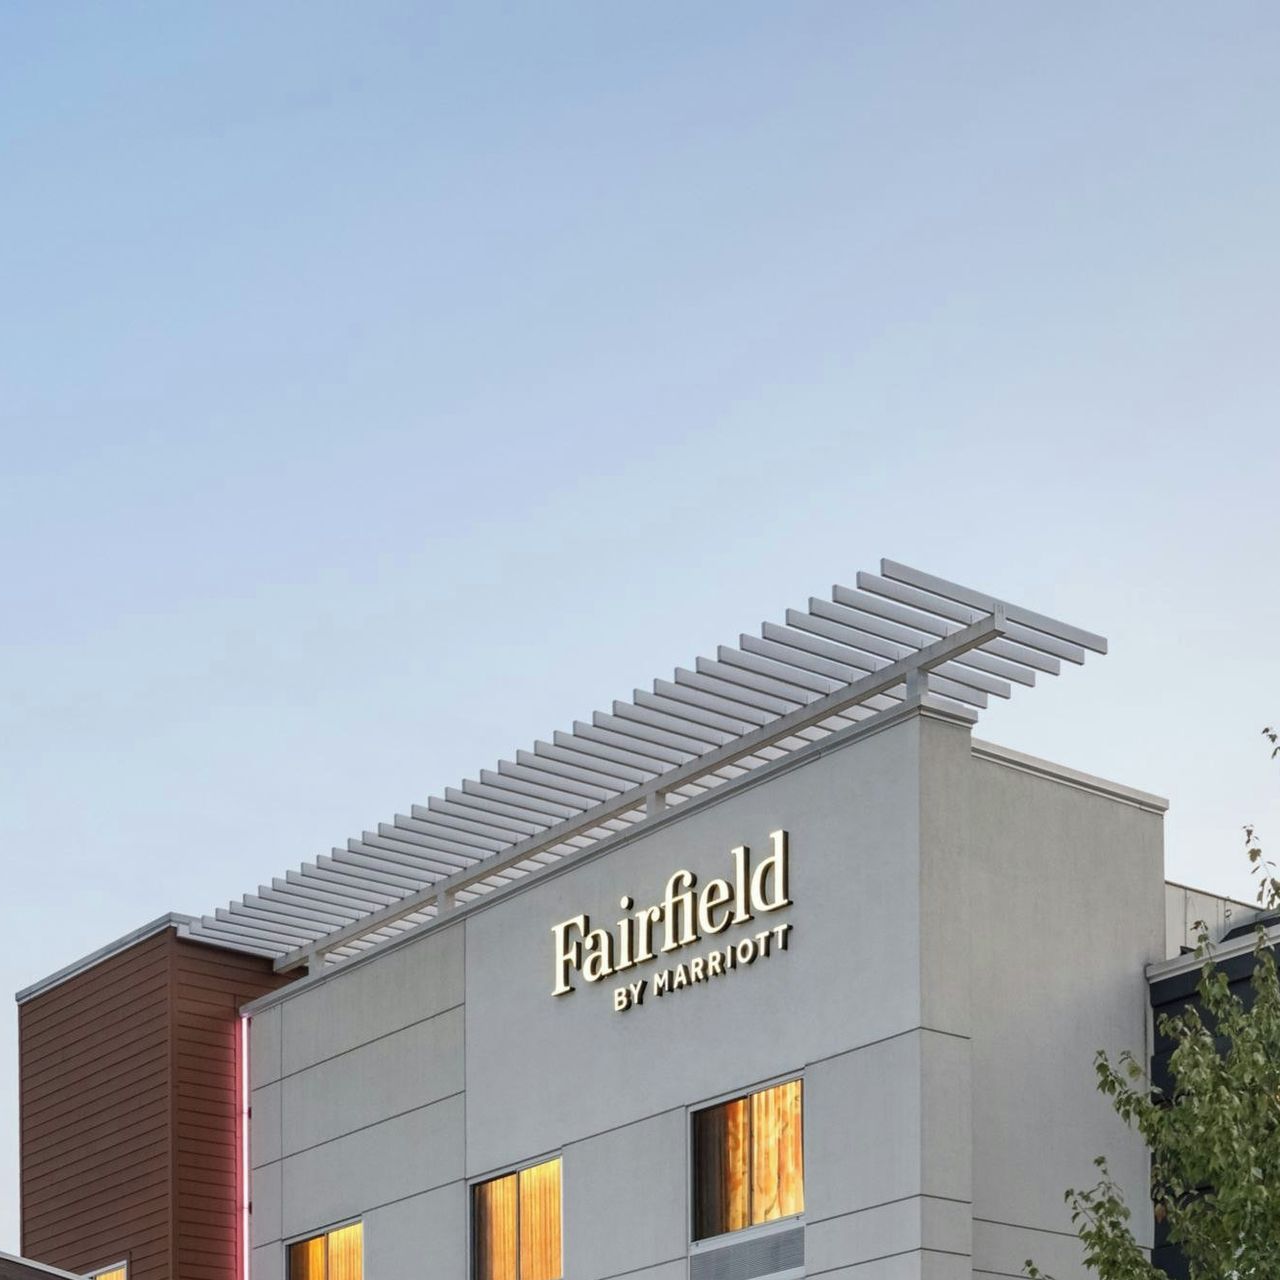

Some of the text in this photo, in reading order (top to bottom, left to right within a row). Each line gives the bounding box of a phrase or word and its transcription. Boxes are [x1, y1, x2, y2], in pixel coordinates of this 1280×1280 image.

[551, 830, 793, 997] Fairfield
[614, 923, 793, 1012] BY MARRIOTT
